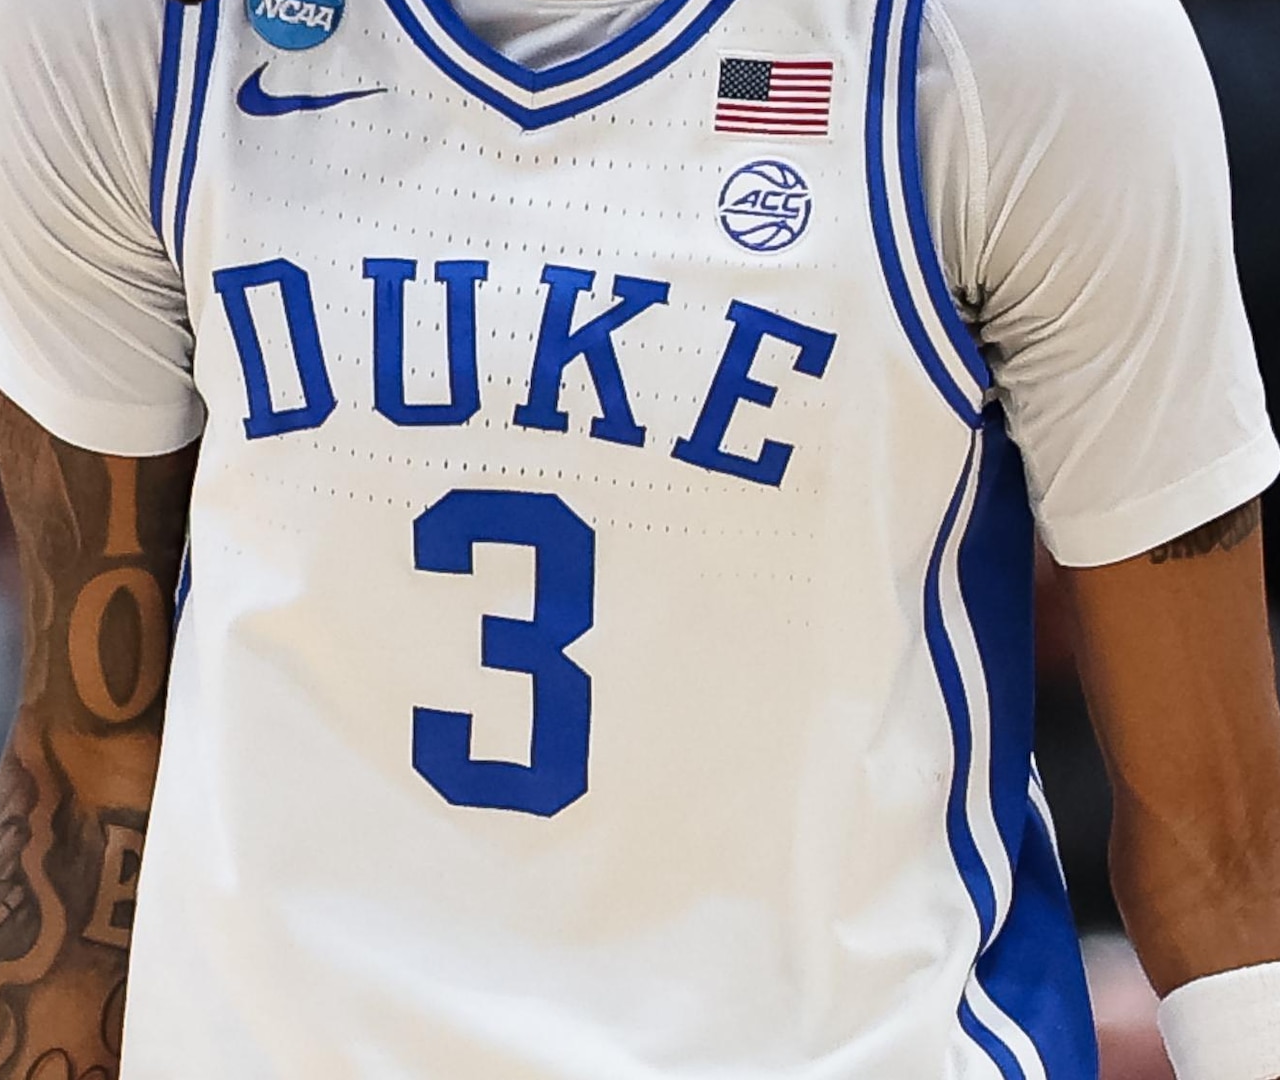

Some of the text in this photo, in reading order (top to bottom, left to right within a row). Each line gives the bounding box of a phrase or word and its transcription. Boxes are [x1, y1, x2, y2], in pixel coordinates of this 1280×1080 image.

[731, 189, 808, 214] ACC
[213, 257, 838, 487] DUKE
[412, 489, 595, 817] 3
